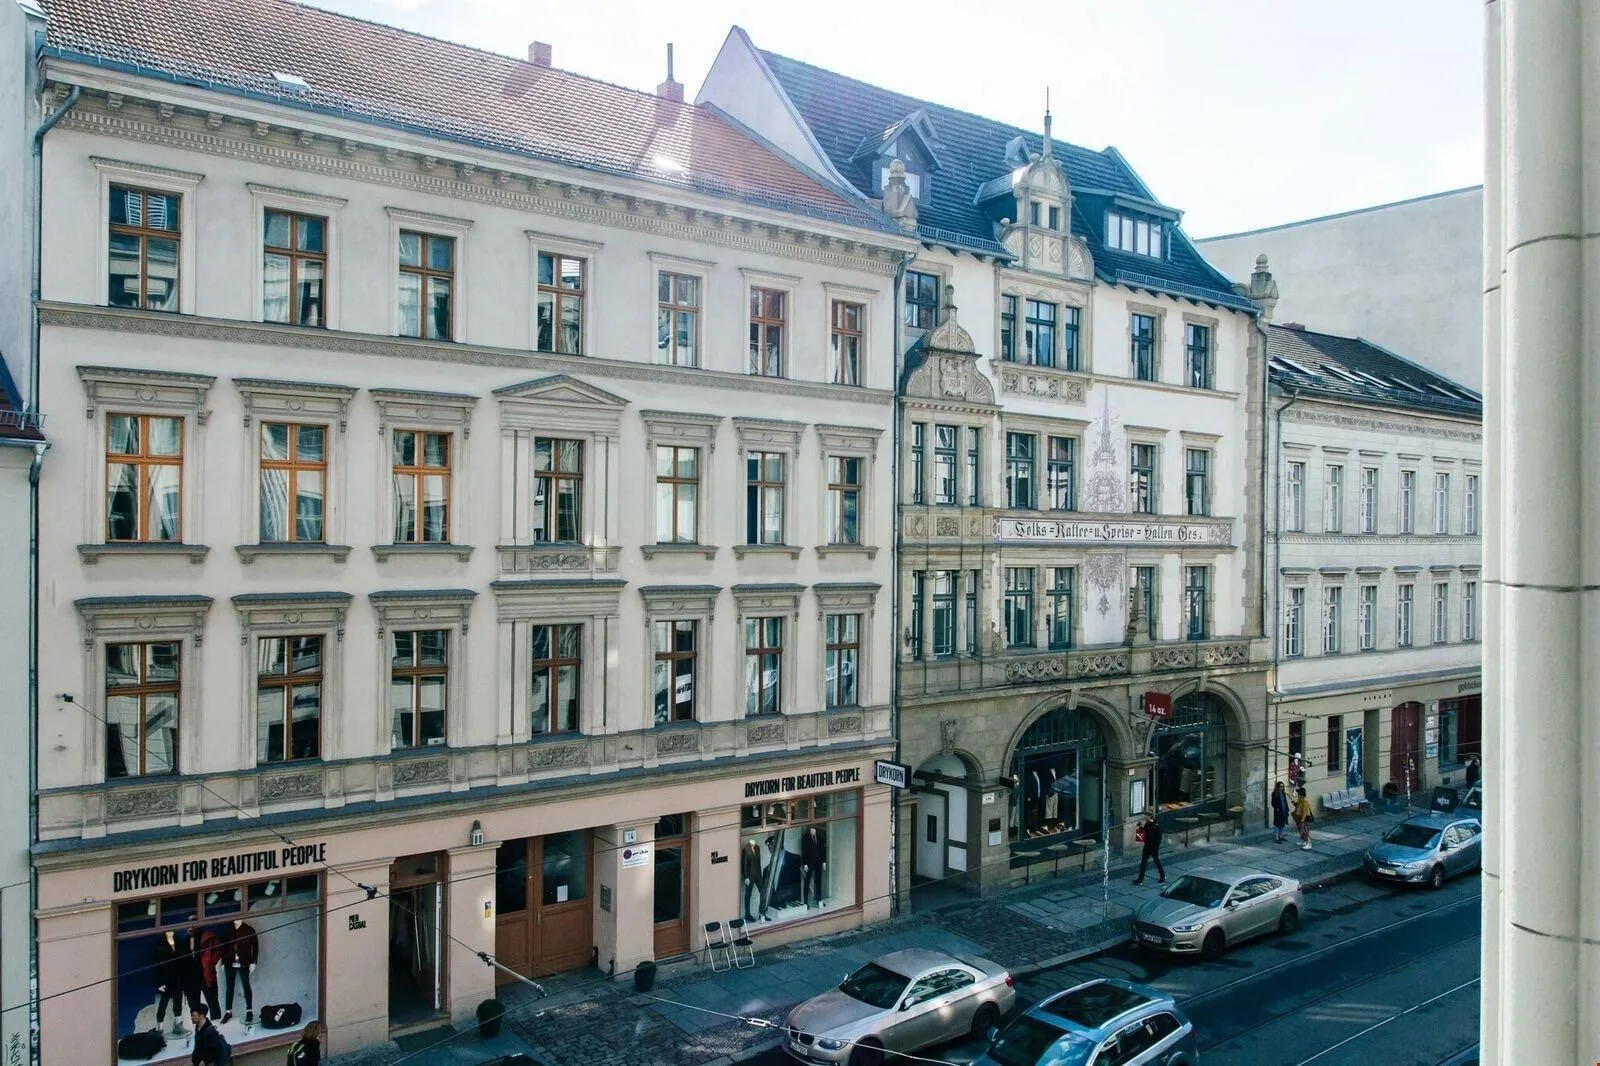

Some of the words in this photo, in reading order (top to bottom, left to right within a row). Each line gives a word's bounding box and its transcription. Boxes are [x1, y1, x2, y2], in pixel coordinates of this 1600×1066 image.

[1149, 703, 1157, 713] 14
[745, 779, 780, 798] DRYKORN
[781, 776, 796, 792] FOR
[797, 771, 834, 790] BEAUTIFUL
[835, 767, 860, 784] PEOPLE
[879, 764, 904, 783] DRYKORN
[113, 863, 179, 893] DRYKORN
[183, 860, 208, 882] FOR
[211, 849, 279, 878] BEAUTIFUL
[282, 842, 327, 867] PEOPLE
